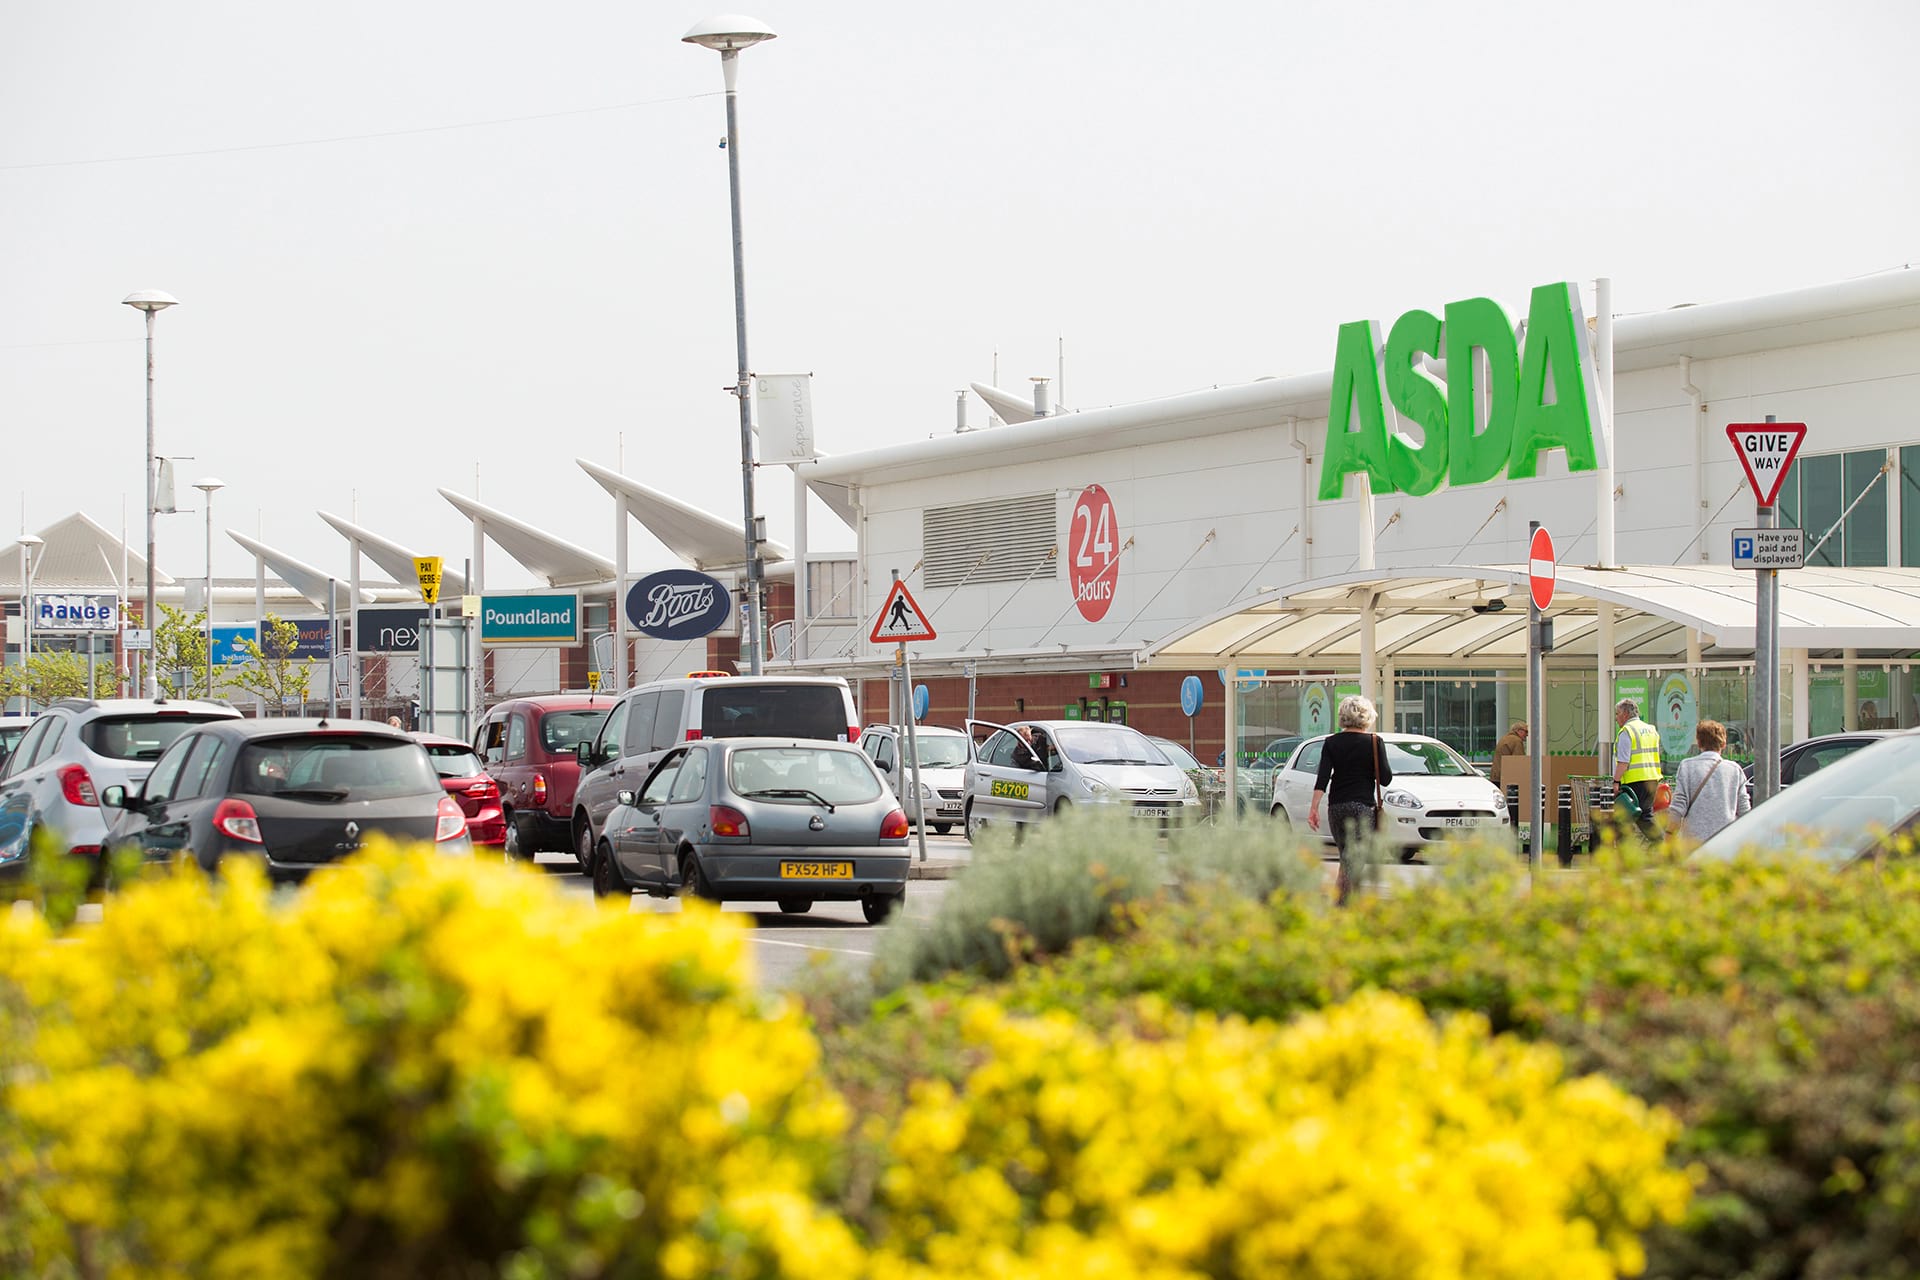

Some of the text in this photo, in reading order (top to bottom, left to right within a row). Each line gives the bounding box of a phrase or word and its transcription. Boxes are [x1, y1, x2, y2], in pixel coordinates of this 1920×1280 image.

[1317, 281, 1600, 500] ASDA
[790, 379, 810, 457] Experience
[1745, 434, 1788, 452] GIVE
[1754, 457, 1781, 469] WAY
[1076, 503, 1113, 567] 24
[1757, 533, 1799, 545] Have you
[1738, 540, 1750, 557] P
[1758, 544, 1797, 555] paid and
[420, 562, 432, 572] PAY
[419, 574, 435, 584] HERE
[1078, 575, 1111, 601] hours
[639, 582, 714, 628] Boots
[485, 608, 571, 625] Poundland
[380, 627, 420, 646] nex
[994, 782, 1028, 797] 54700
[1445, 818, 1463, 827] PE14
[786, 863, 819, 876] FX52
